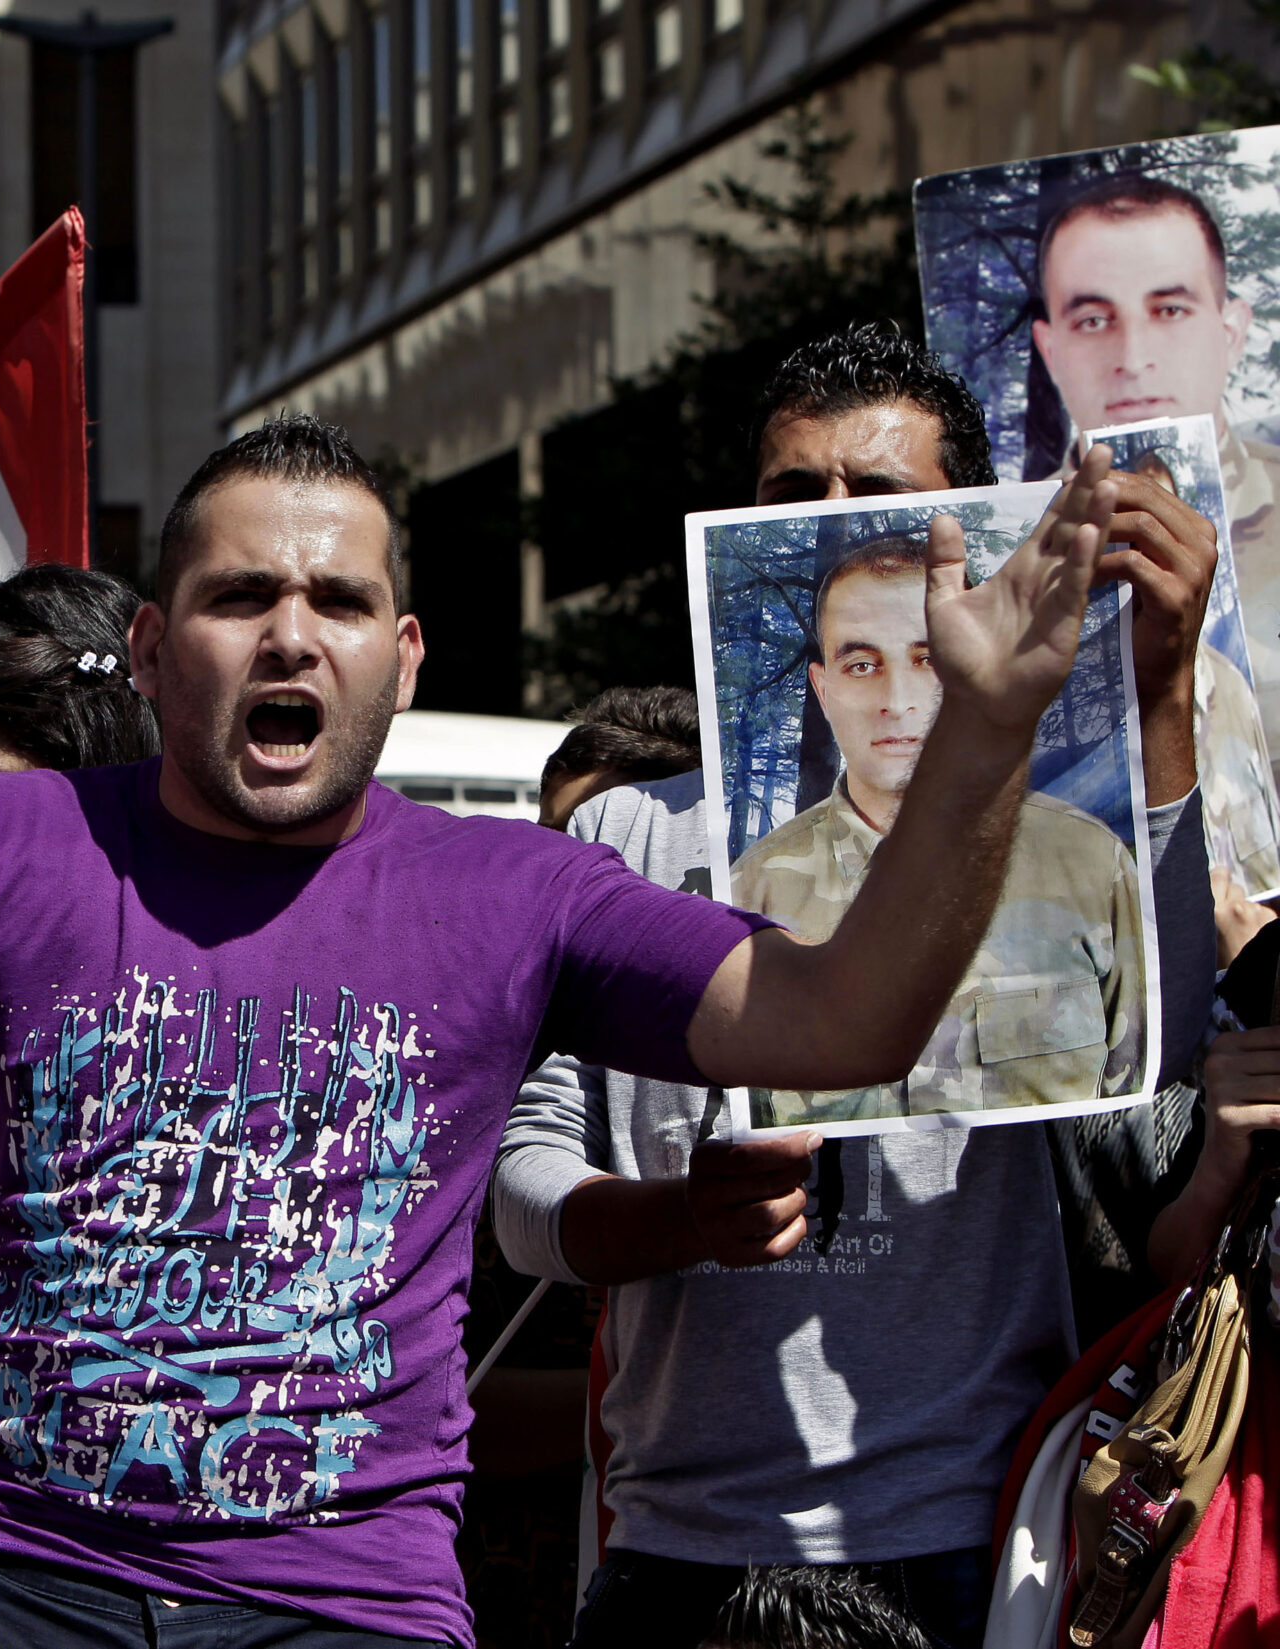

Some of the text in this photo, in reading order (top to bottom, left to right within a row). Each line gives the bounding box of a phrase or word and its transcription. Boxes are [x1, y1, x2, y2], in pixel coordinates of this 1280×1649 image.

[829, 1233, 861, 1254] Art
[869, 1233, 893, 1255] Of
[817, 1257, 829, 1274] &
